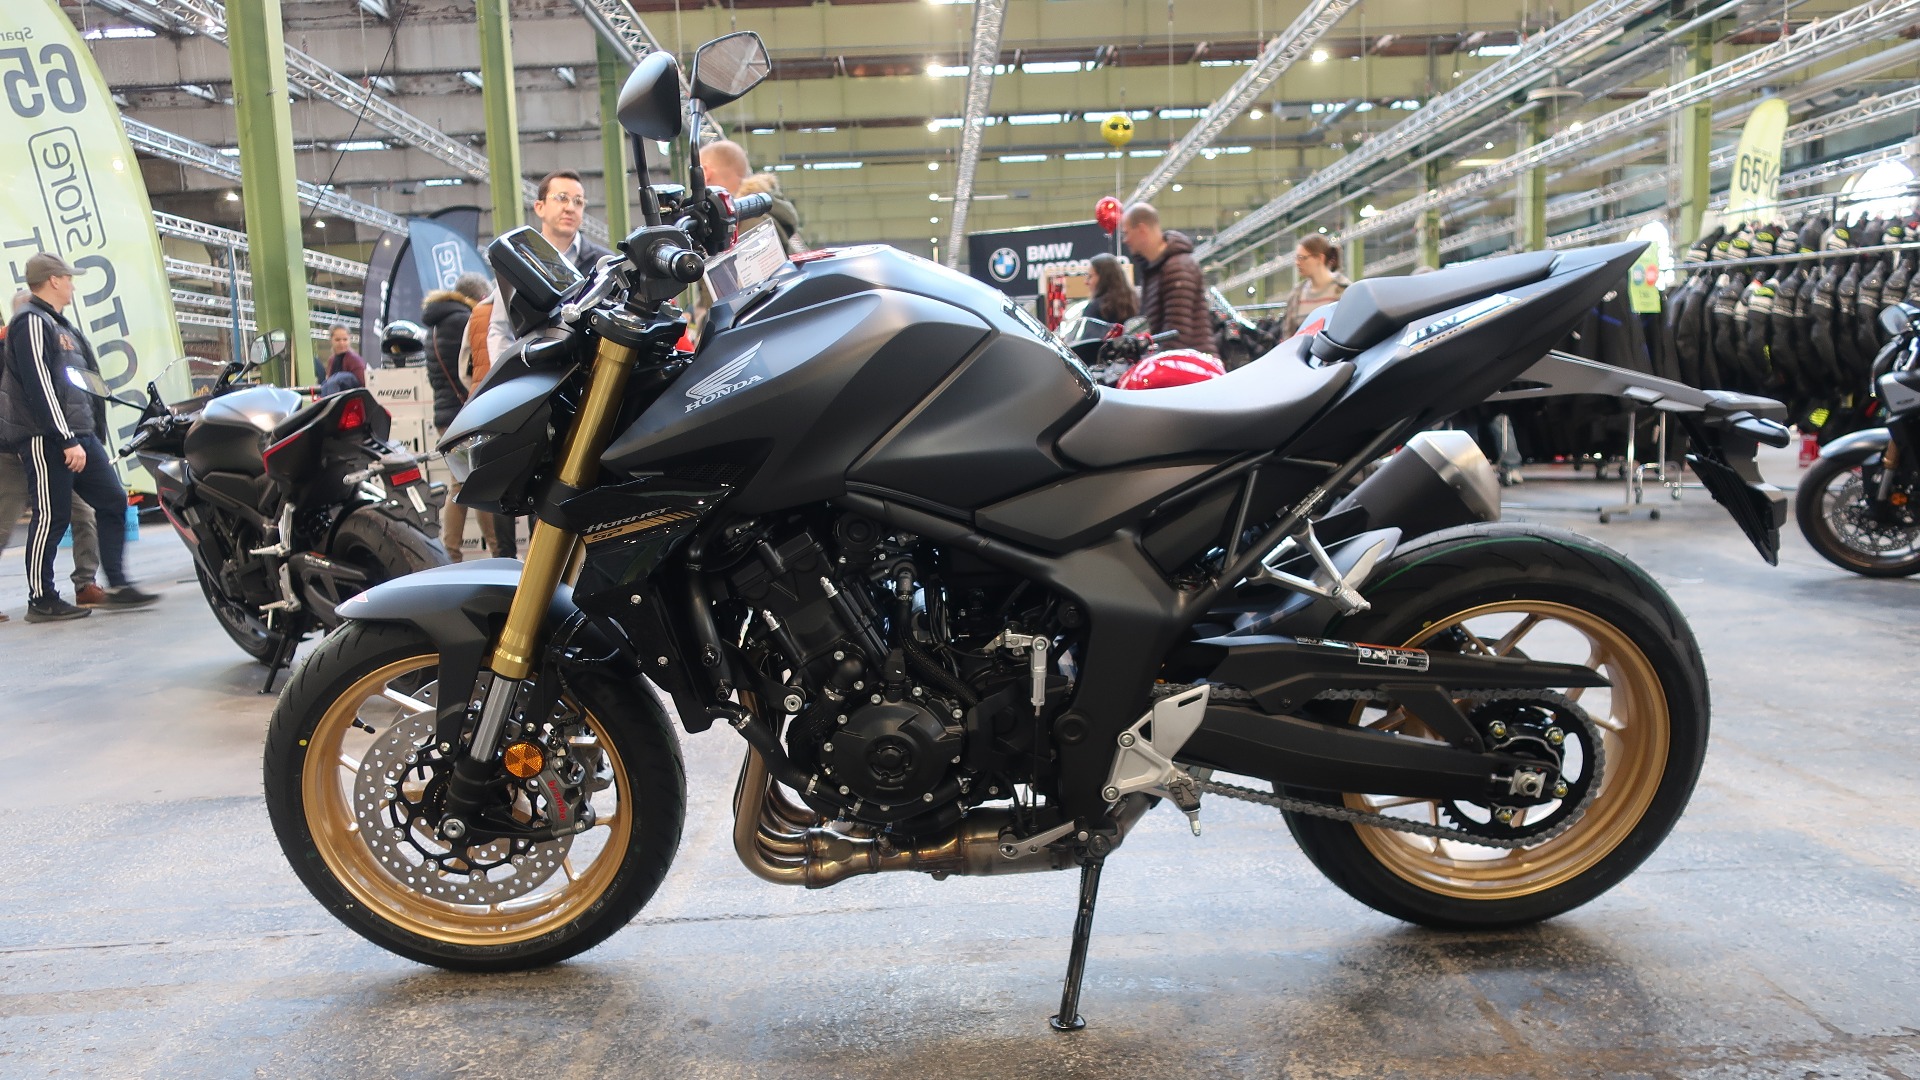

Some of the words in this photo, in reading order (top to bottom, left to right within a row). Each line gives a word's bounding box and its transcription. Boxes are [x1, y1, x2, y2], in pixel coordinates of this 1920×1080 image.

[1026, 242, 1073, 262] BMW
[685, 375, 764, 413] HONDA
[548, 780, 568, 820] brembo
